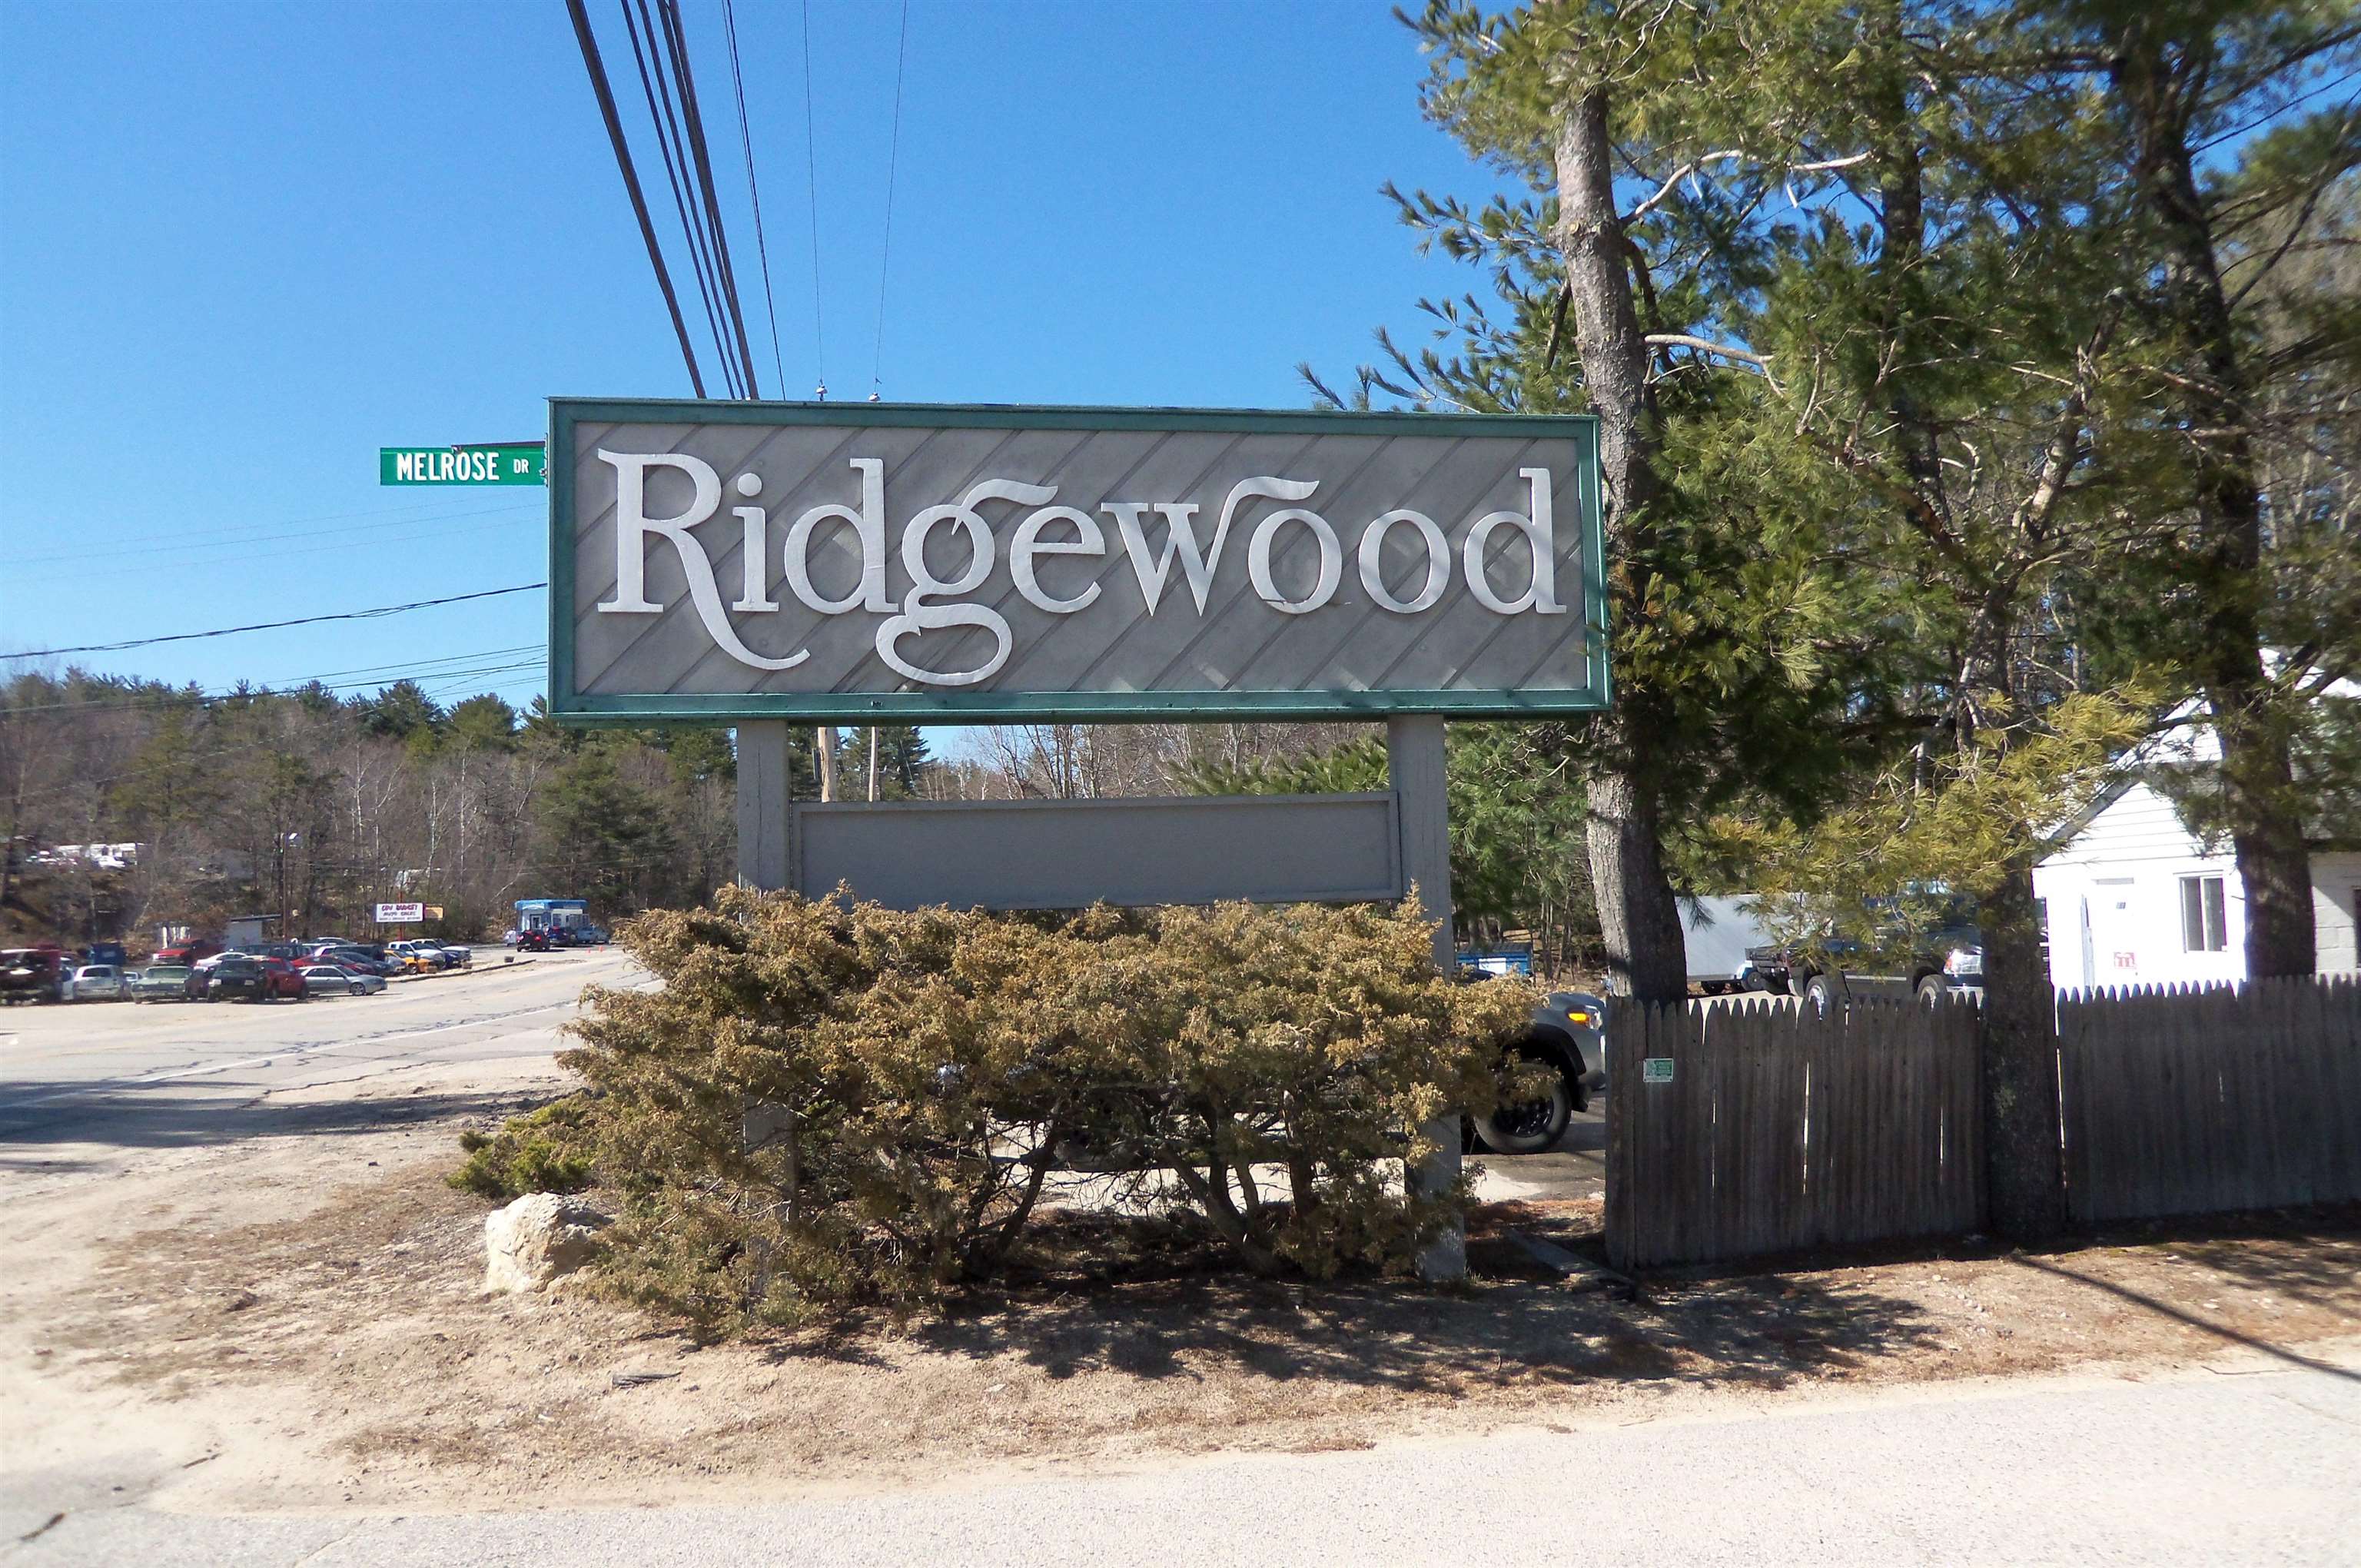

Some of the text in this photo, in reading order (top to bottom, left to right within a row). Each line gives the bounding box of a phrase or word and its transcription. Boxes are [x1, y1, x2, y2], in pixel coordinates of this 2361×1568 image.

[397, 451, 530, 481] MELROSE DR
[597, 447, 1567, 686] Ridgewood
